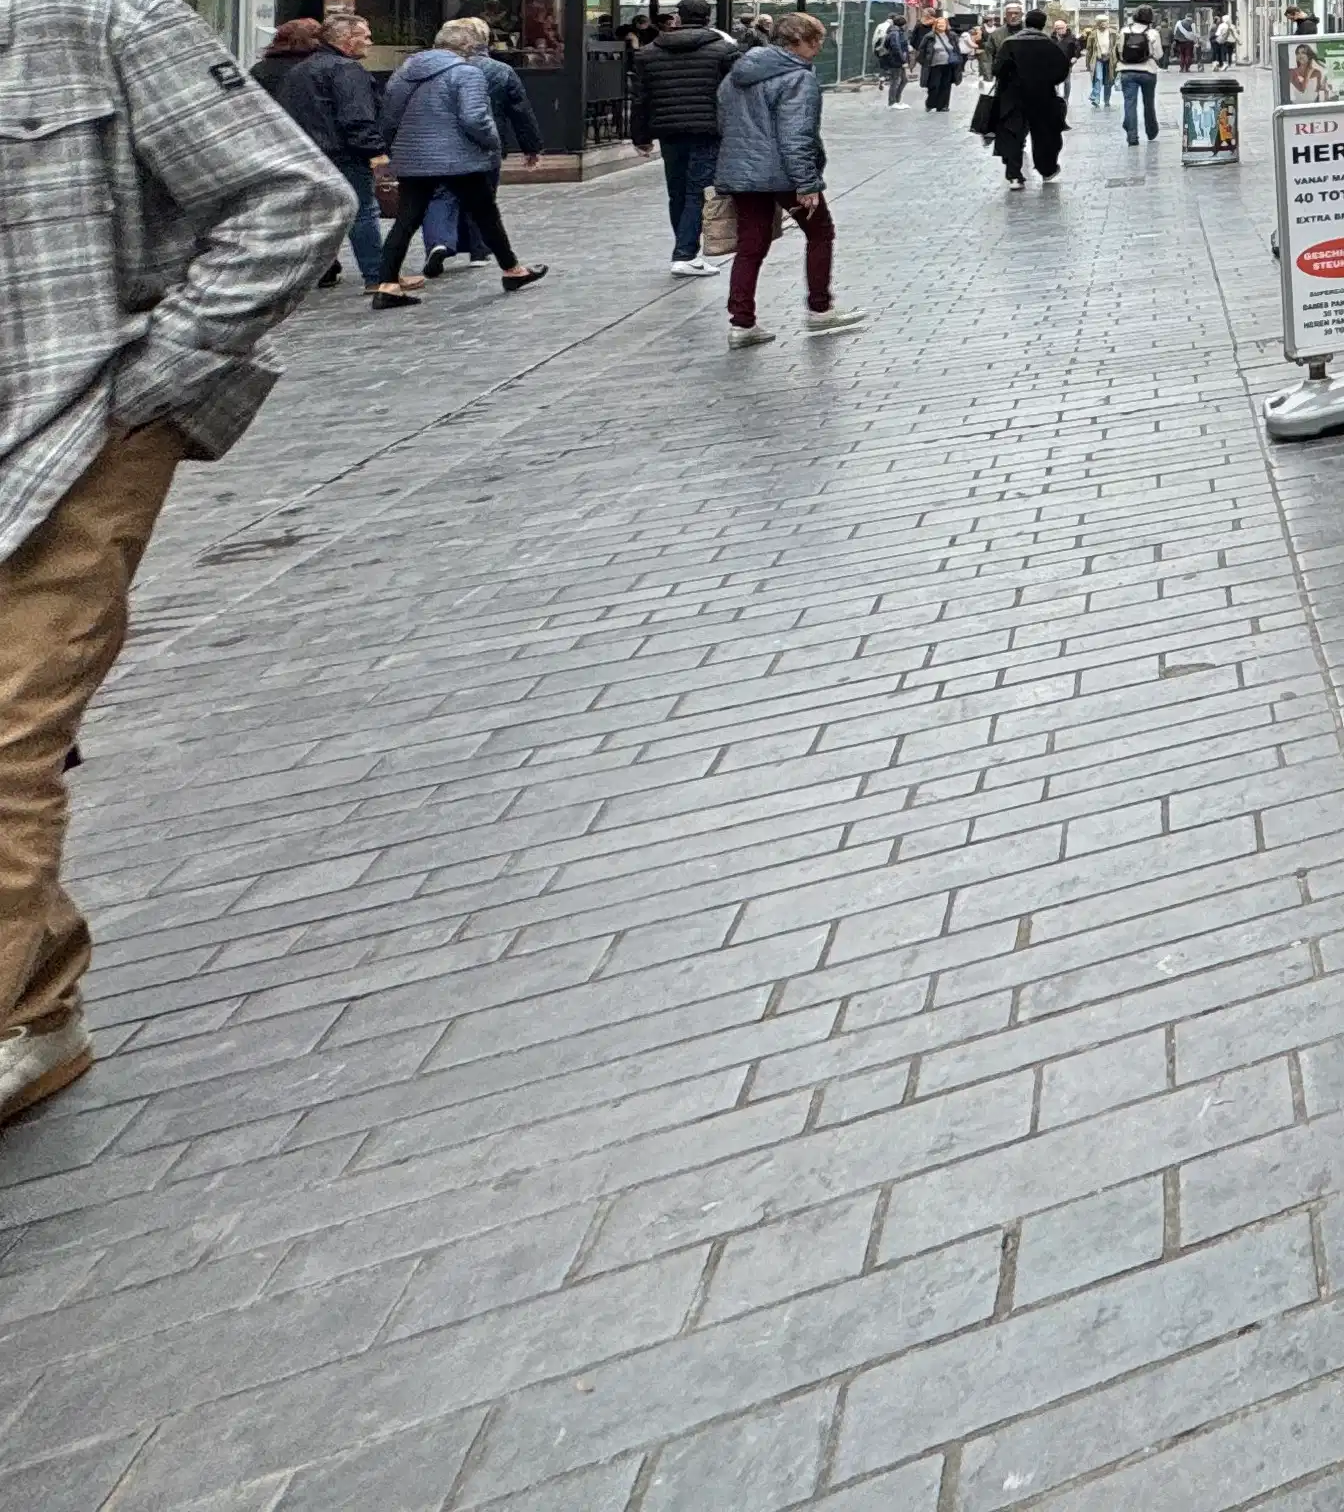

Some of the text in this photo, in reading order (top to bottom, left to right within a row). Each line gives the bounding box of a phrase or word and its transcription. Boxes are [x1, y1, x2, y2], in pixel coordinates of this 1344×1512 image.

[1295, 120, 1339, 136] RED
[1294, 175, 1328, 185] VANAF
[1294, 192, 1314, 204] 40
[1296, 213, 1332, 224] EXTRA
